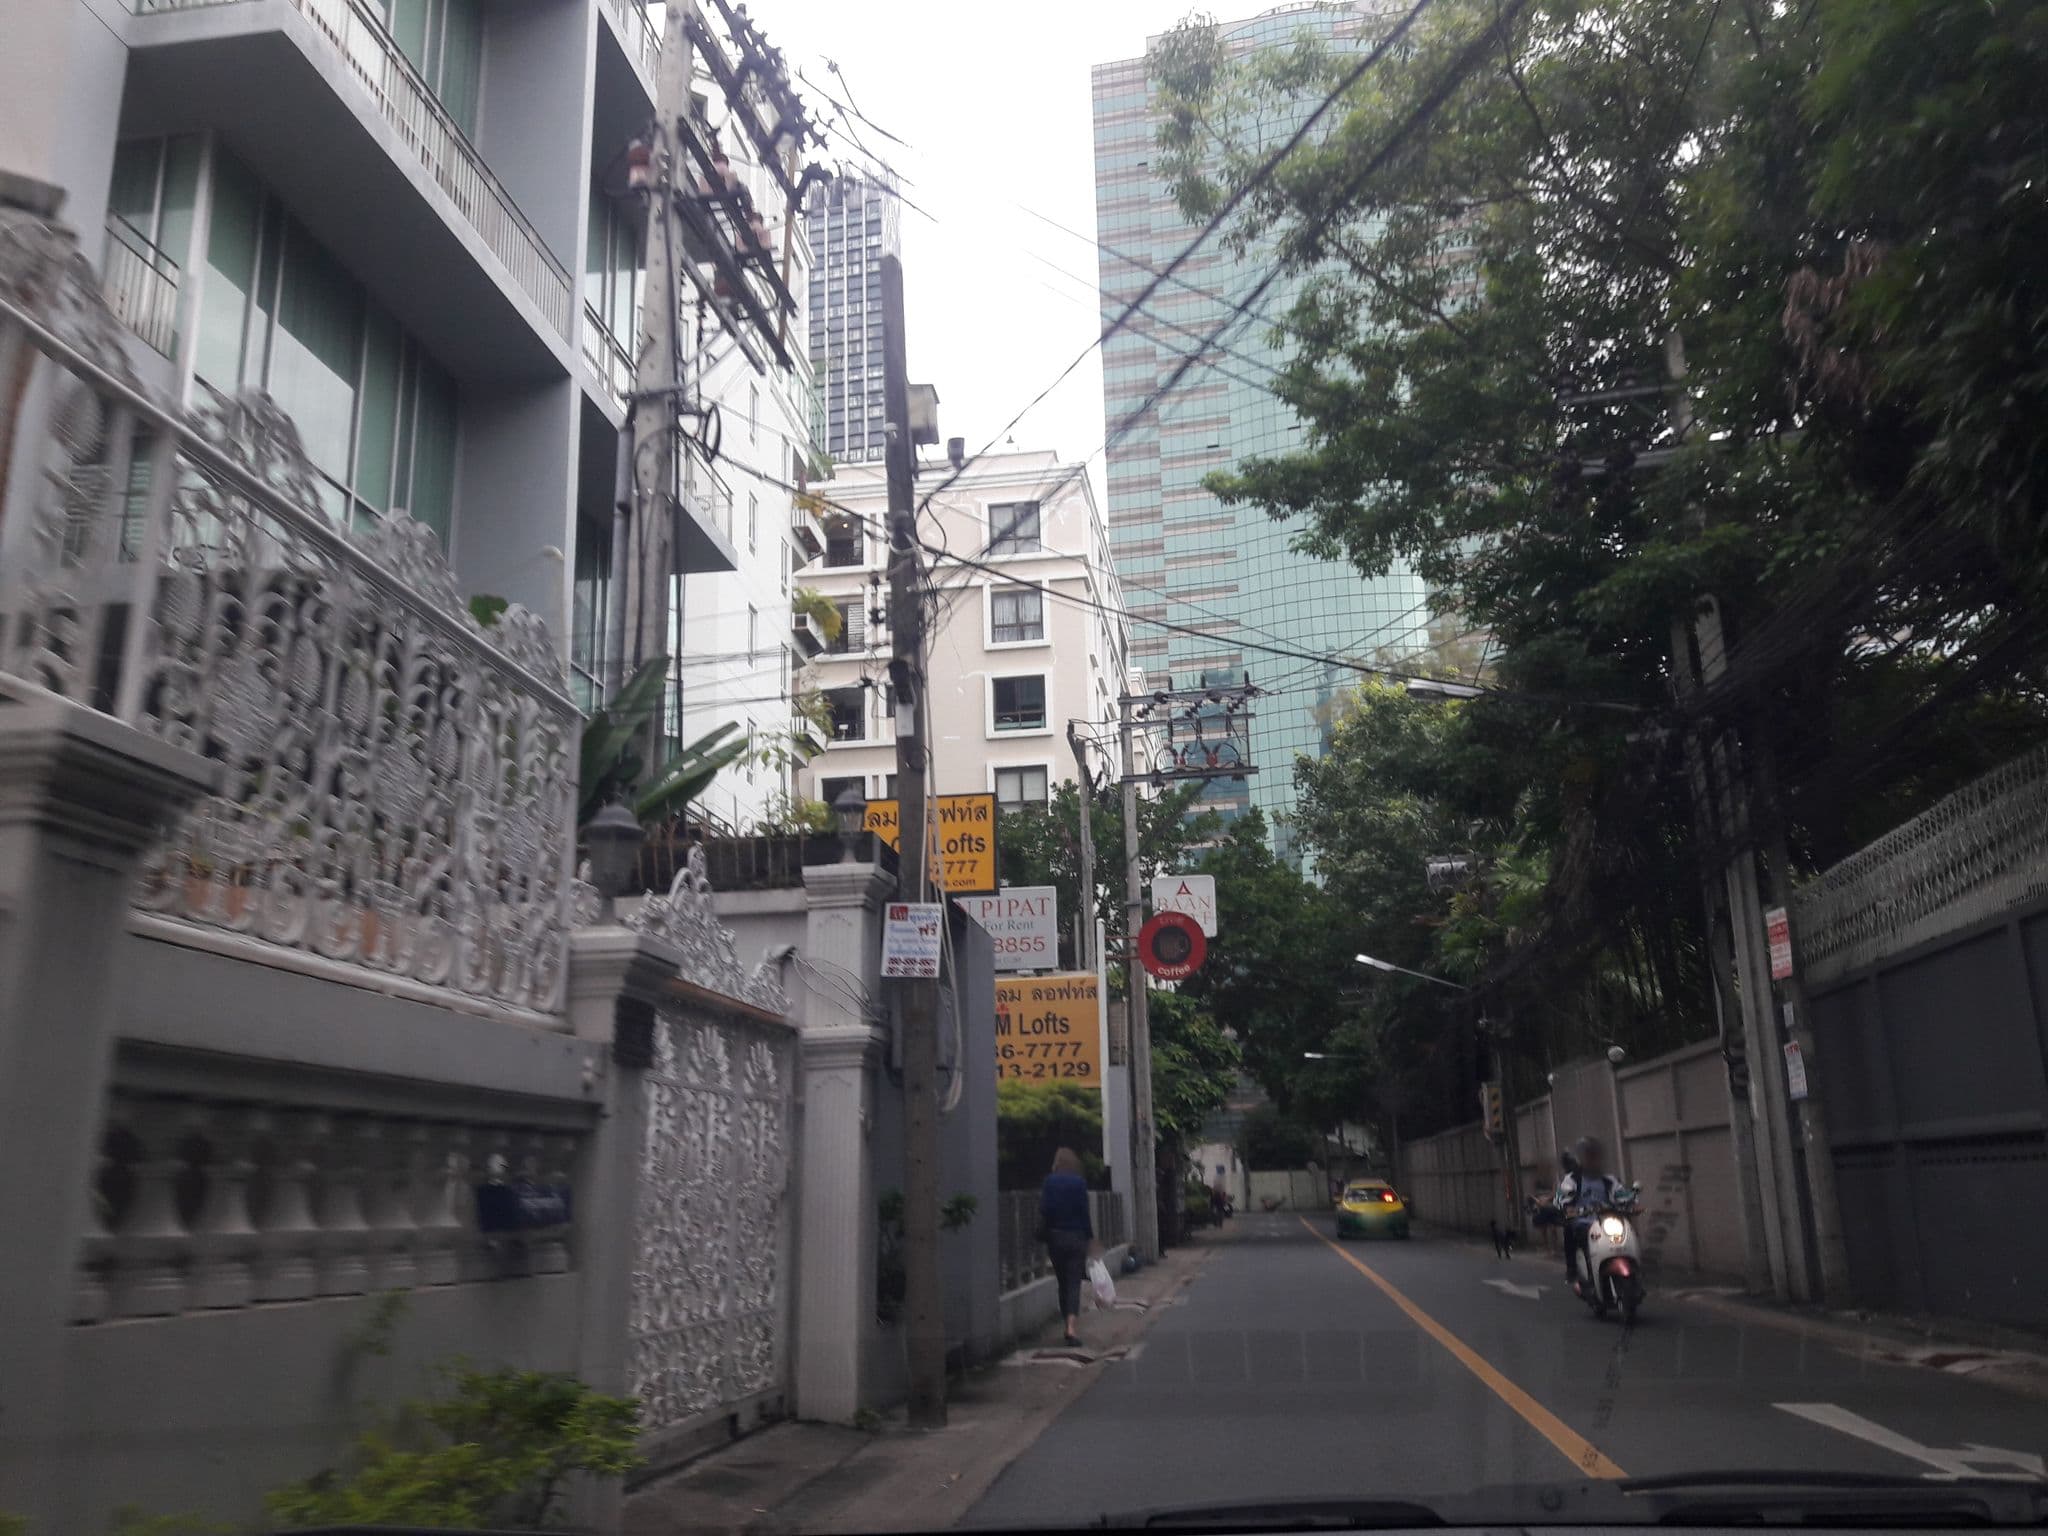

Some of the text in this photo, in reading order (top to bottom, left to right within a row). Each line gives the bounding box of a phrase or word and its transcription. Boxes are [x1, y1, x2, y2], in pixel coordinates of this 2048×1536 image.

[981, 897, 1050, 918] PIPAT
[1007, 920, 1034, 930] Rent
[1019, 1011, 1070, 1035] Lofts
